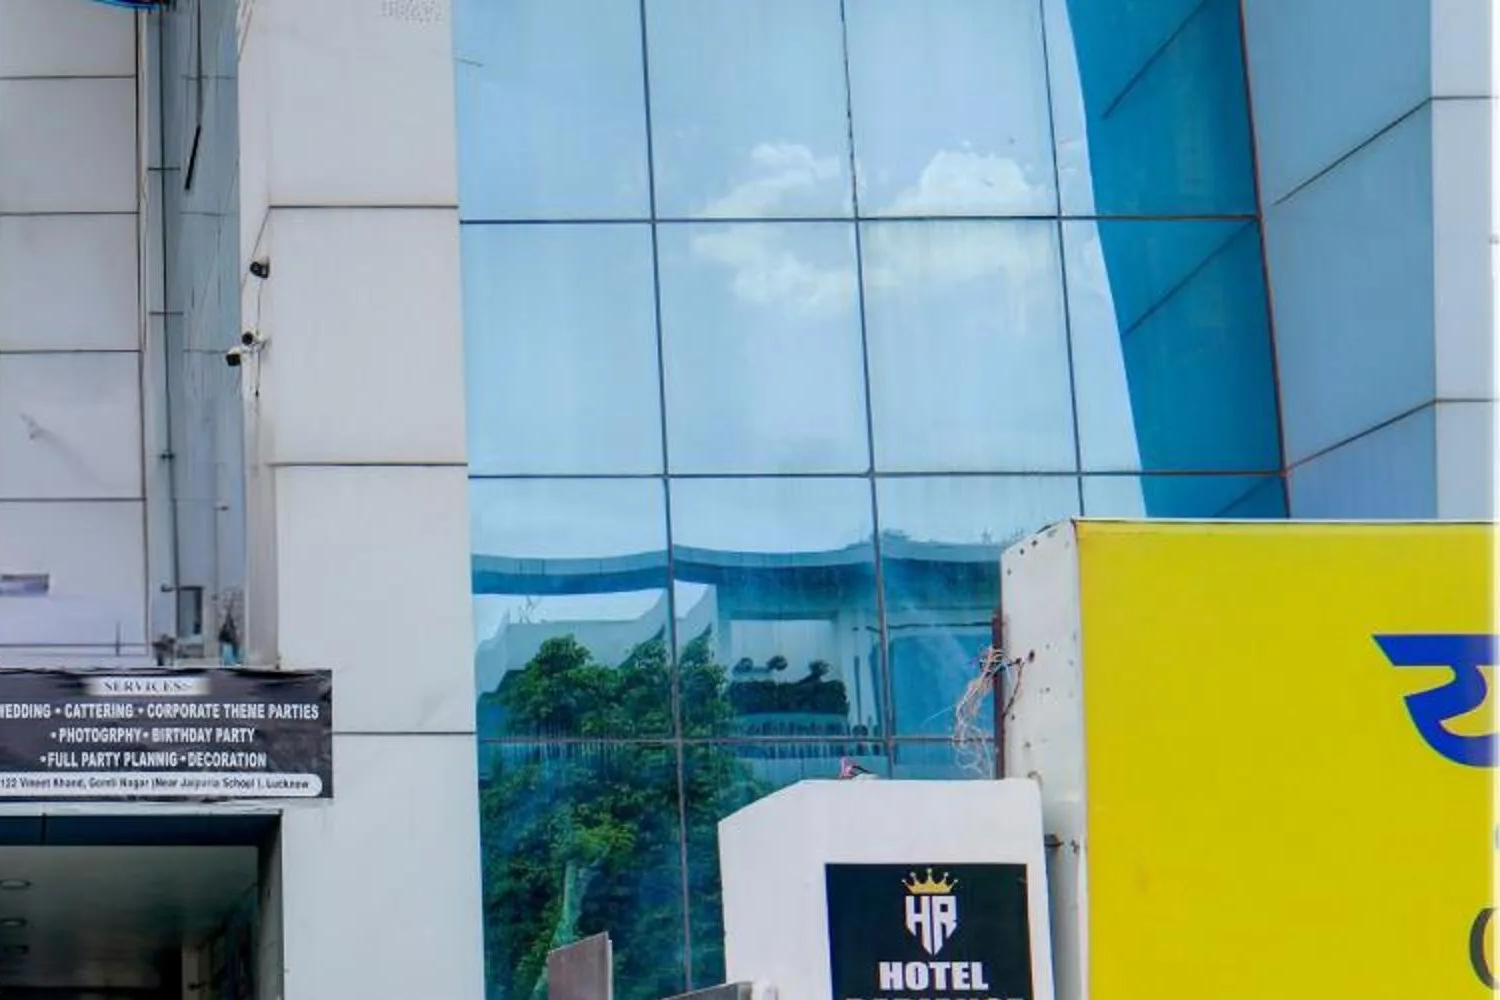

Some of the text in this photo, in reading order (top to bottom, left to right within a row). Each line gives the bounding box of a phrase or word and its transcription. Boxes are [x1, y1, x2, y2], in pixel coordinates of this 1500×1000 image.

[65, 703, 134, 718] CATTERING
[147, 703, 220, 718] CORPORATE
[268, 704, 319, 720] PARTIES
[59, 727, 255, 743] PHOTOGRPHY BIRTHDAY PARTY
[47, 752, 78, 767] FULL
[81, 752, 121, 767] PARTY
[188, 752, 267, 767] DECORATION
[905, 895, 957, 956] HR
[878, 961, 989, 991] HOTEL
